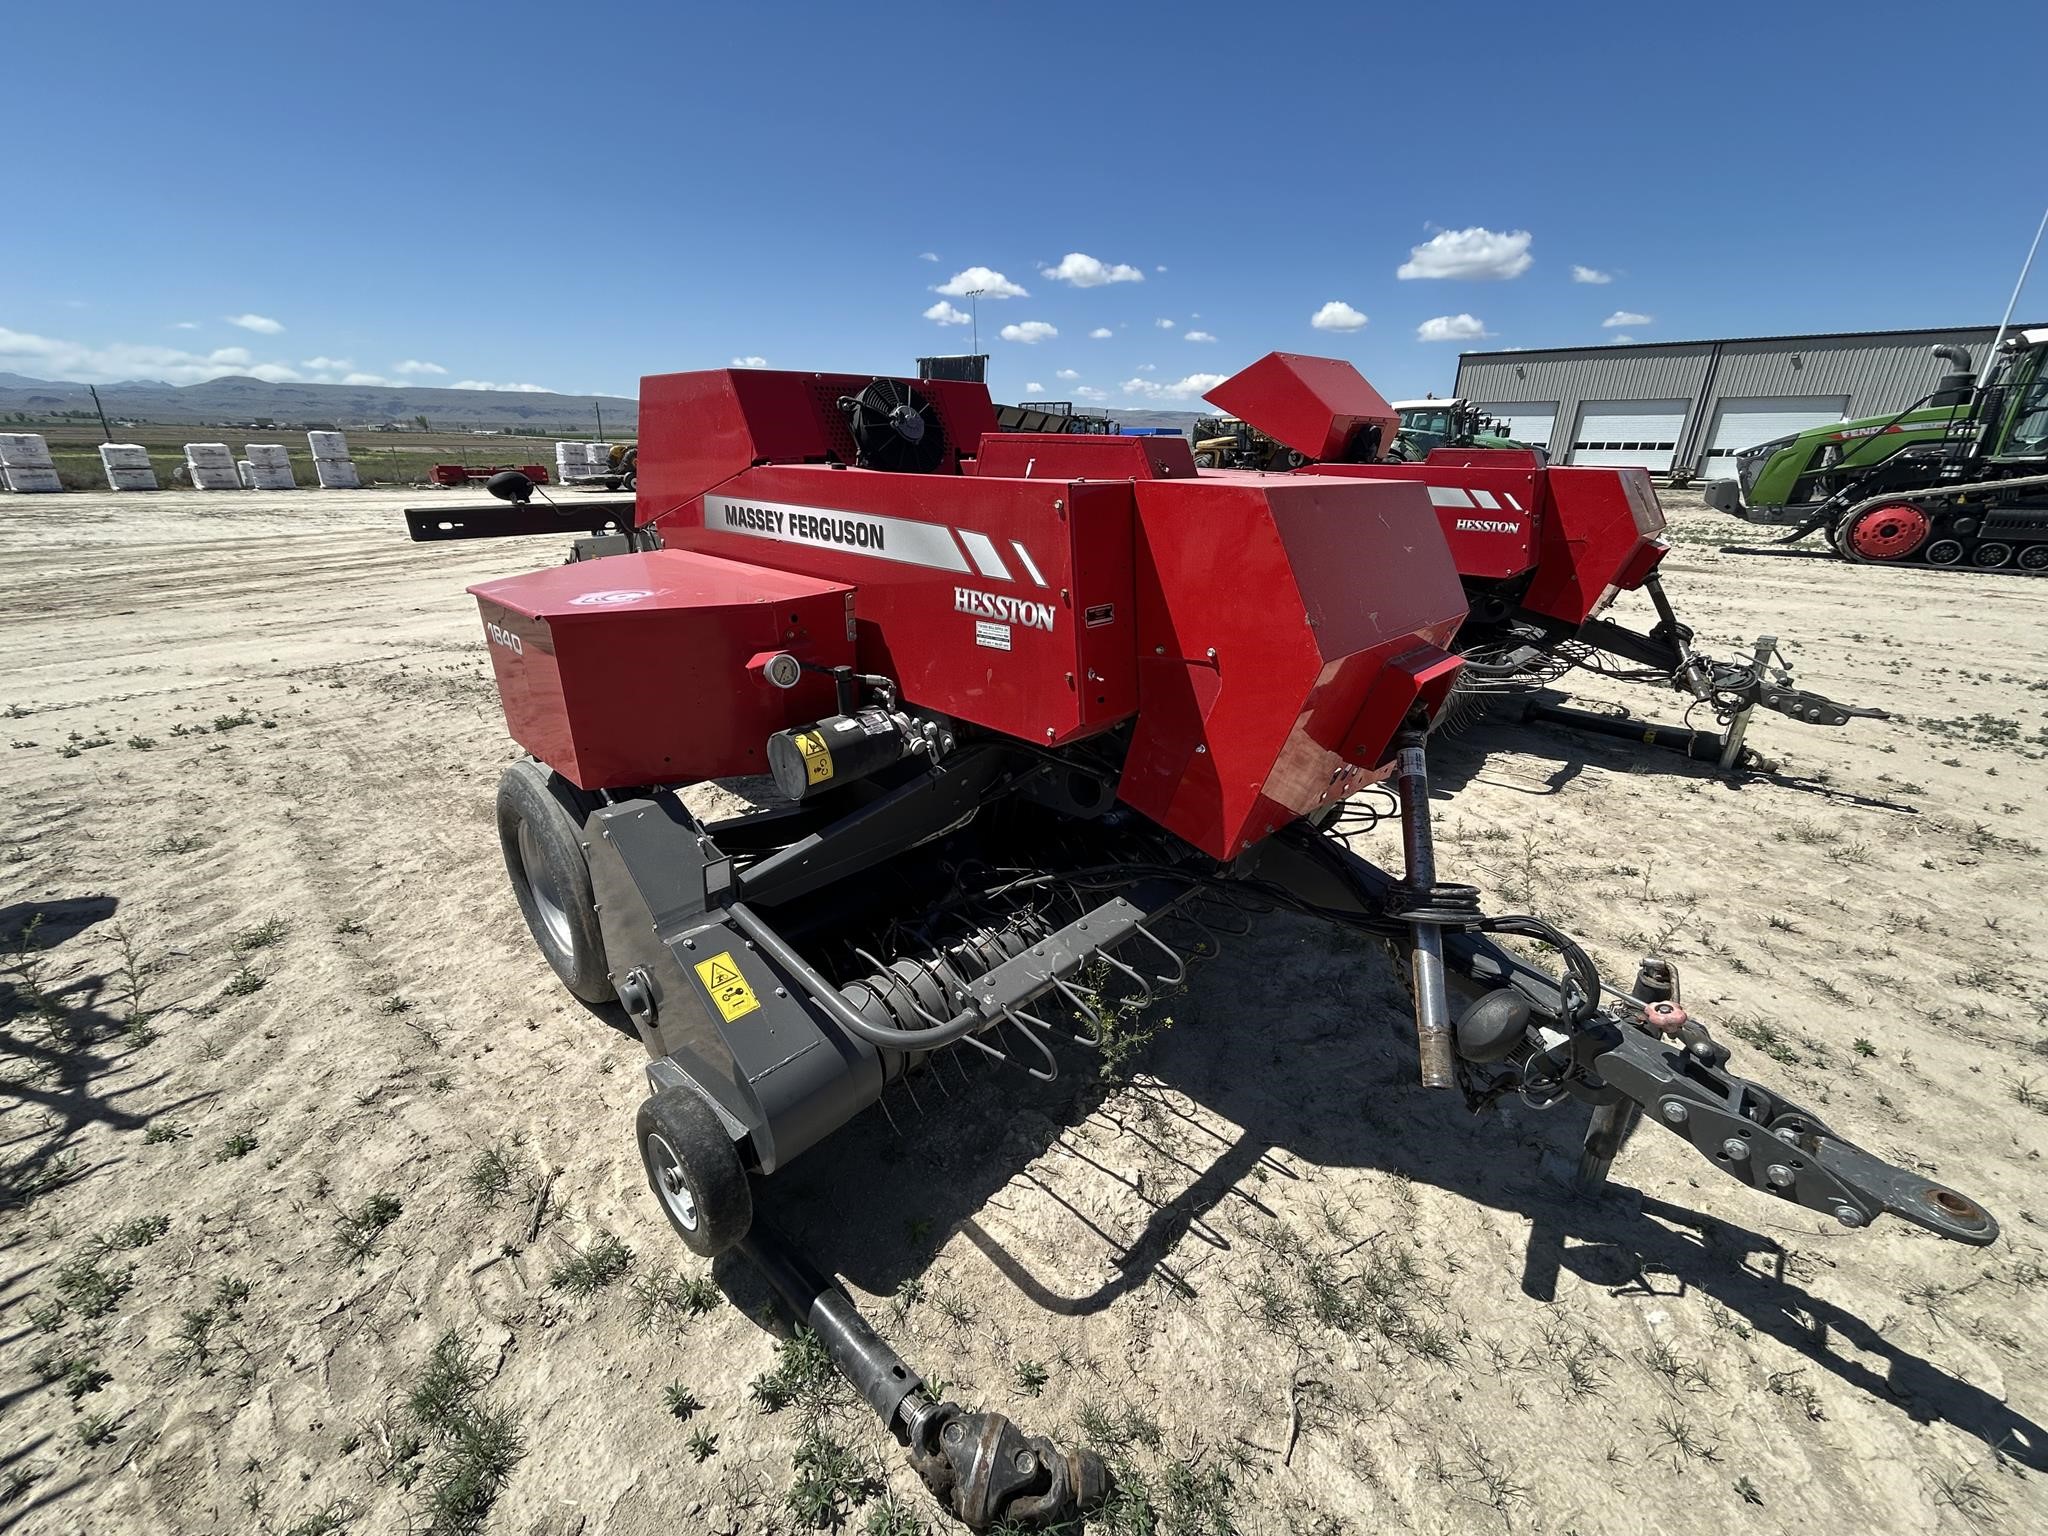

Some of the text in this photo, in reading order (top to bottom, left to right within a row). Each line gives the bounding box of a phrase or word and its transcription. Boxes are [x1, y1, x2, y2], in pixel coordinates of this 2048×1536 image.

[724, 504, 885, 551] MASSEY FERGUSON
[1456, 518, 1520, 534] HESSTON
[954, 587, 1056, 632] HESSTON
[487, 621, 523, 656] 1840
